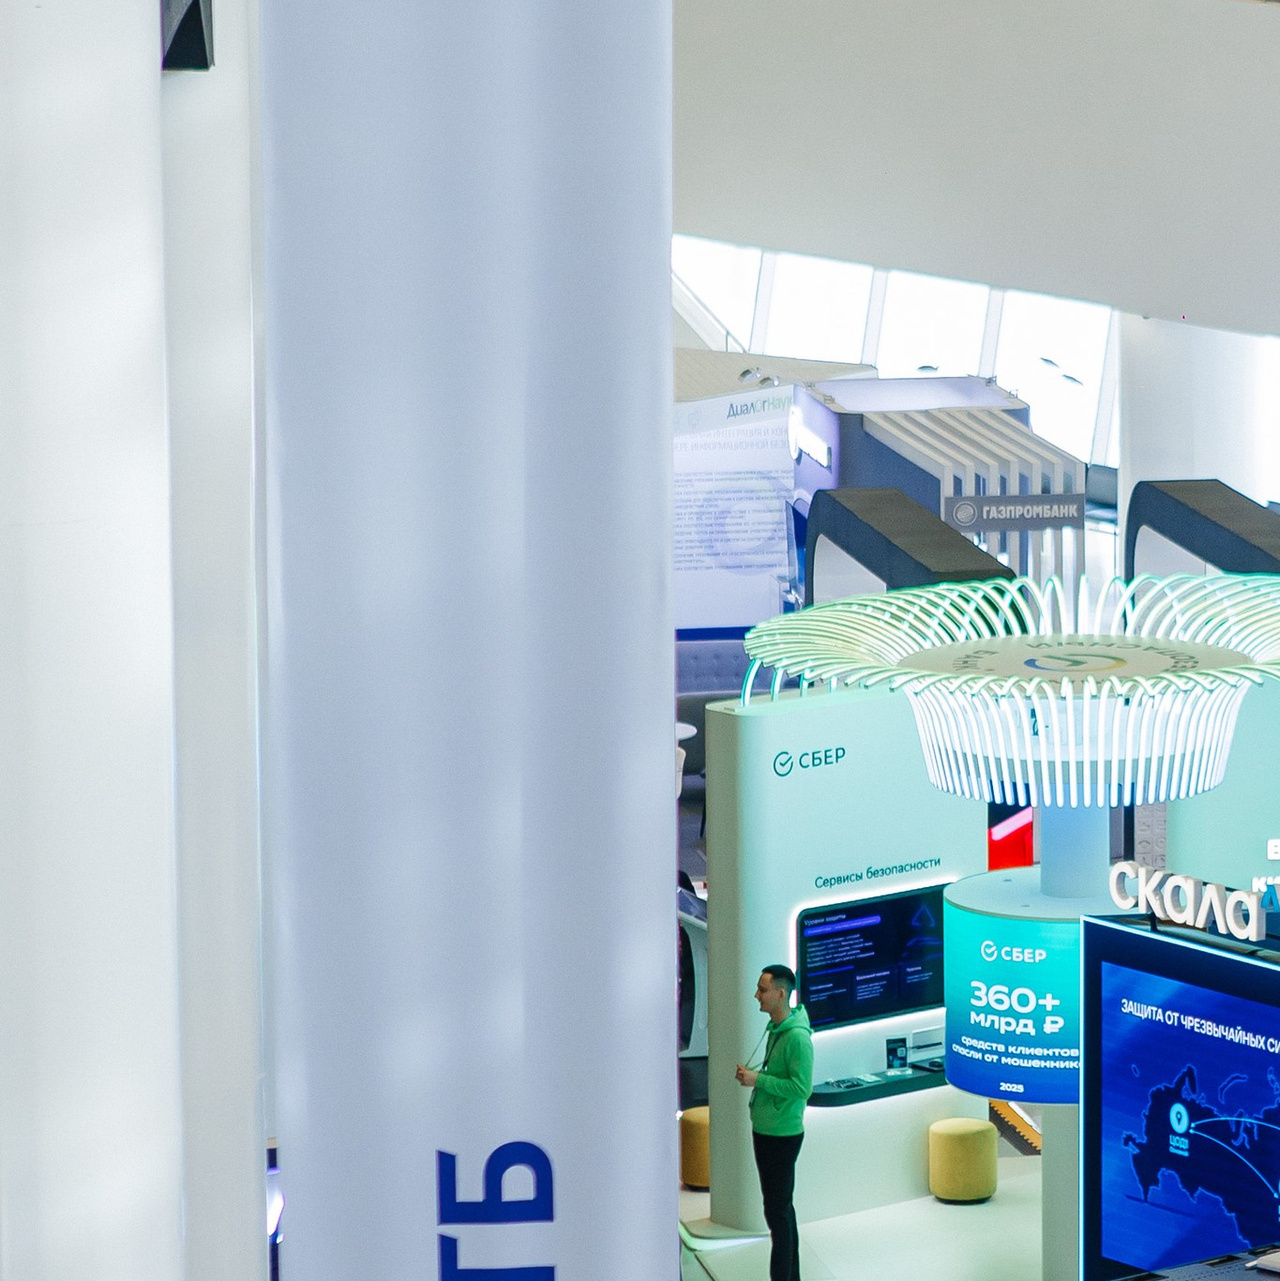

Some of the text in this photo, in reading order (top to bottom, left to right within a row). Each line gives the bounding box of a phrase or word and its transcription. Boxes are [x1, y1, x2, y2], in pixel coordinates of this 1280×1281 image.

[982, 504, 1078, 519] ГАЗПРОМБАНК
[799, 746, 846, 769] СБЕР
[814, 857, 941, 888] Сервисы безопасности
[1001, 947, 1047, 963] СБЕР
[970, 981, 1060, 1014] 360+
[970, 1011, 1036, 1036] млрд
[1121, 998, 1164, 1024] ЗАЩИТА
[1165, 1009, 1179, 1027] ОТ
[1180, 1014, 1265, 1051] ЧРЕЗВЫЧАЙНЫХ
[952, 1043, 1080, 1069] спасли от мошенник
[961, 1036, 1079, 1058] средств клиентов
[999, 1082, 1025, 1094] 2025
